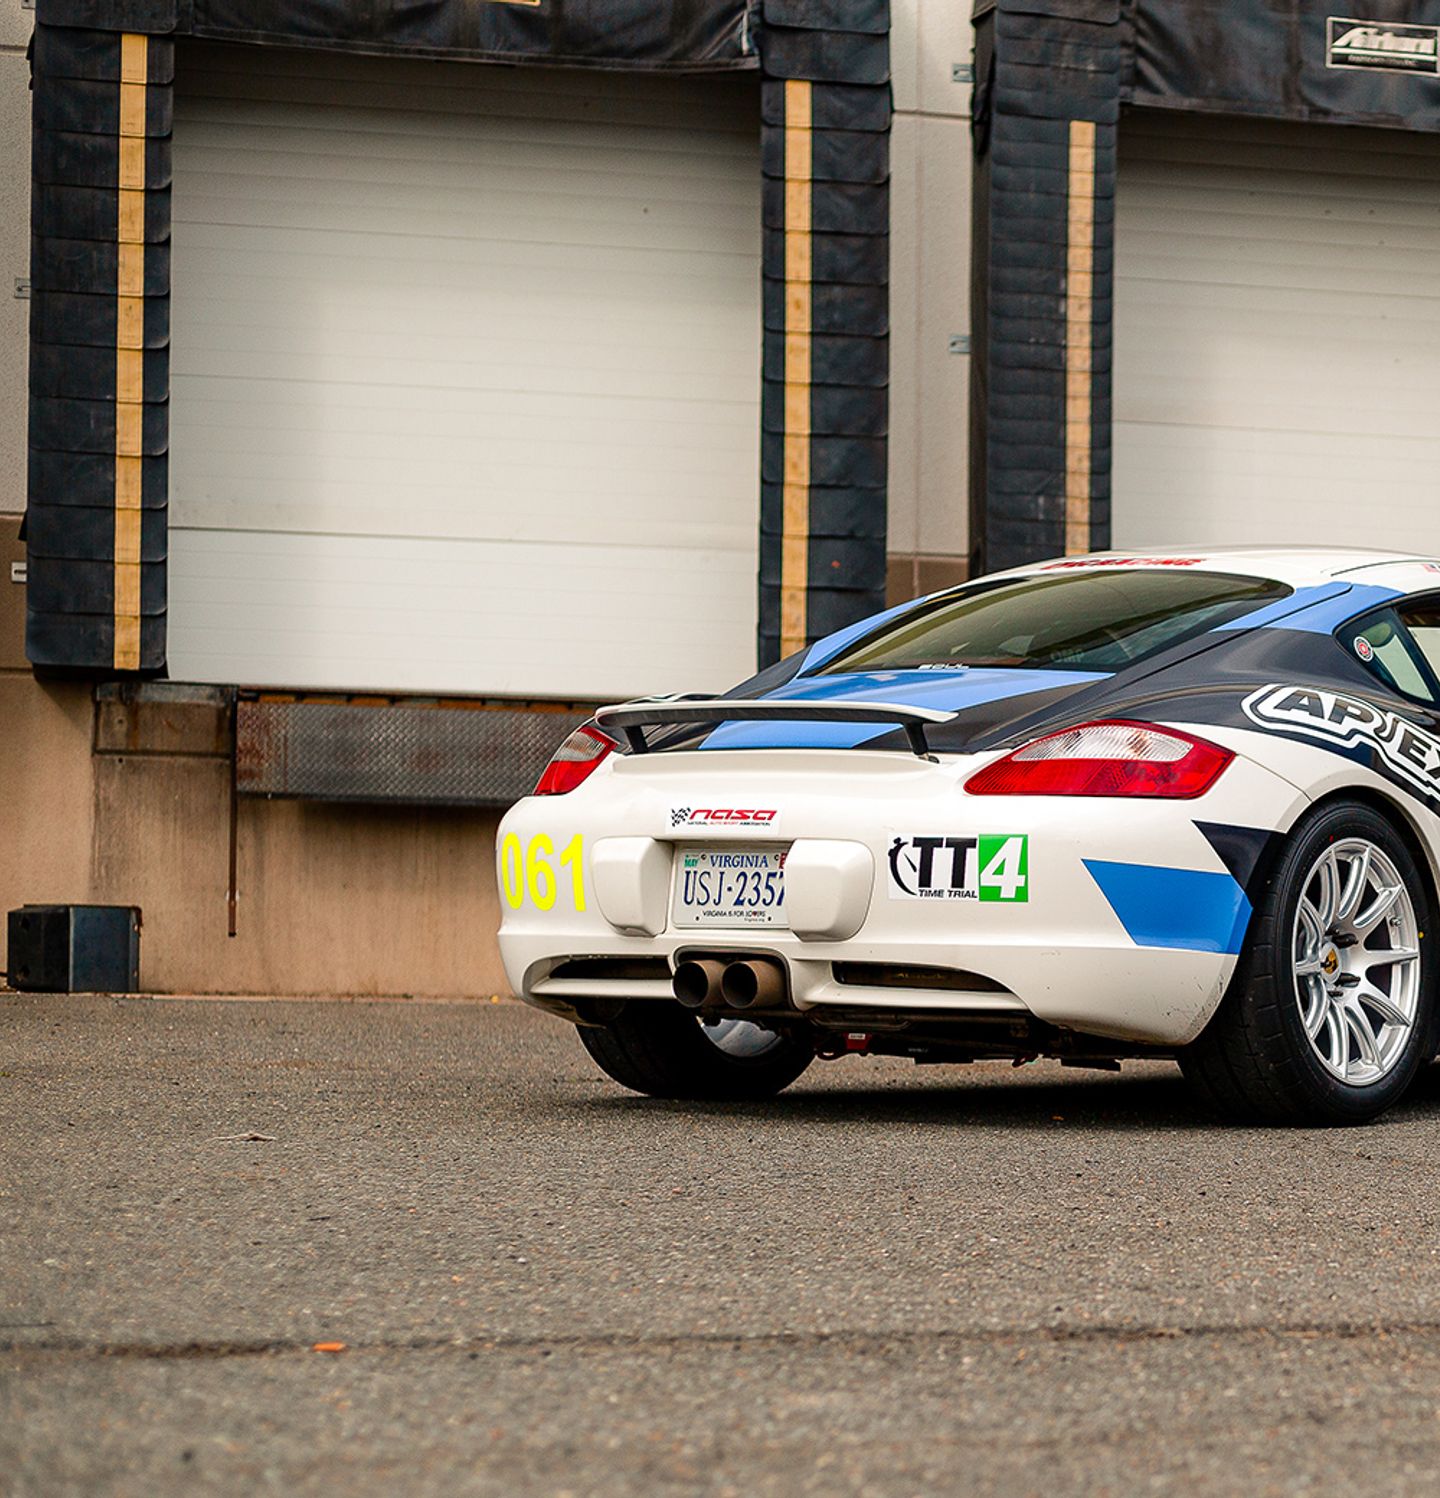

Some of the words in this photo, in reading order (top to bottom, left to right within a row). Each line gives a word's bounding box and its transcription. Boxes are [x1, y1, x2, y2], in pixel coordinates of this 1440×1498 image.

[710, 855, 769, 868] VIRGINIA
[502, 831, 586, 912] 061
[919, 889, 945, 898] TIME
[947, 890, 978, 899] TRIAL
